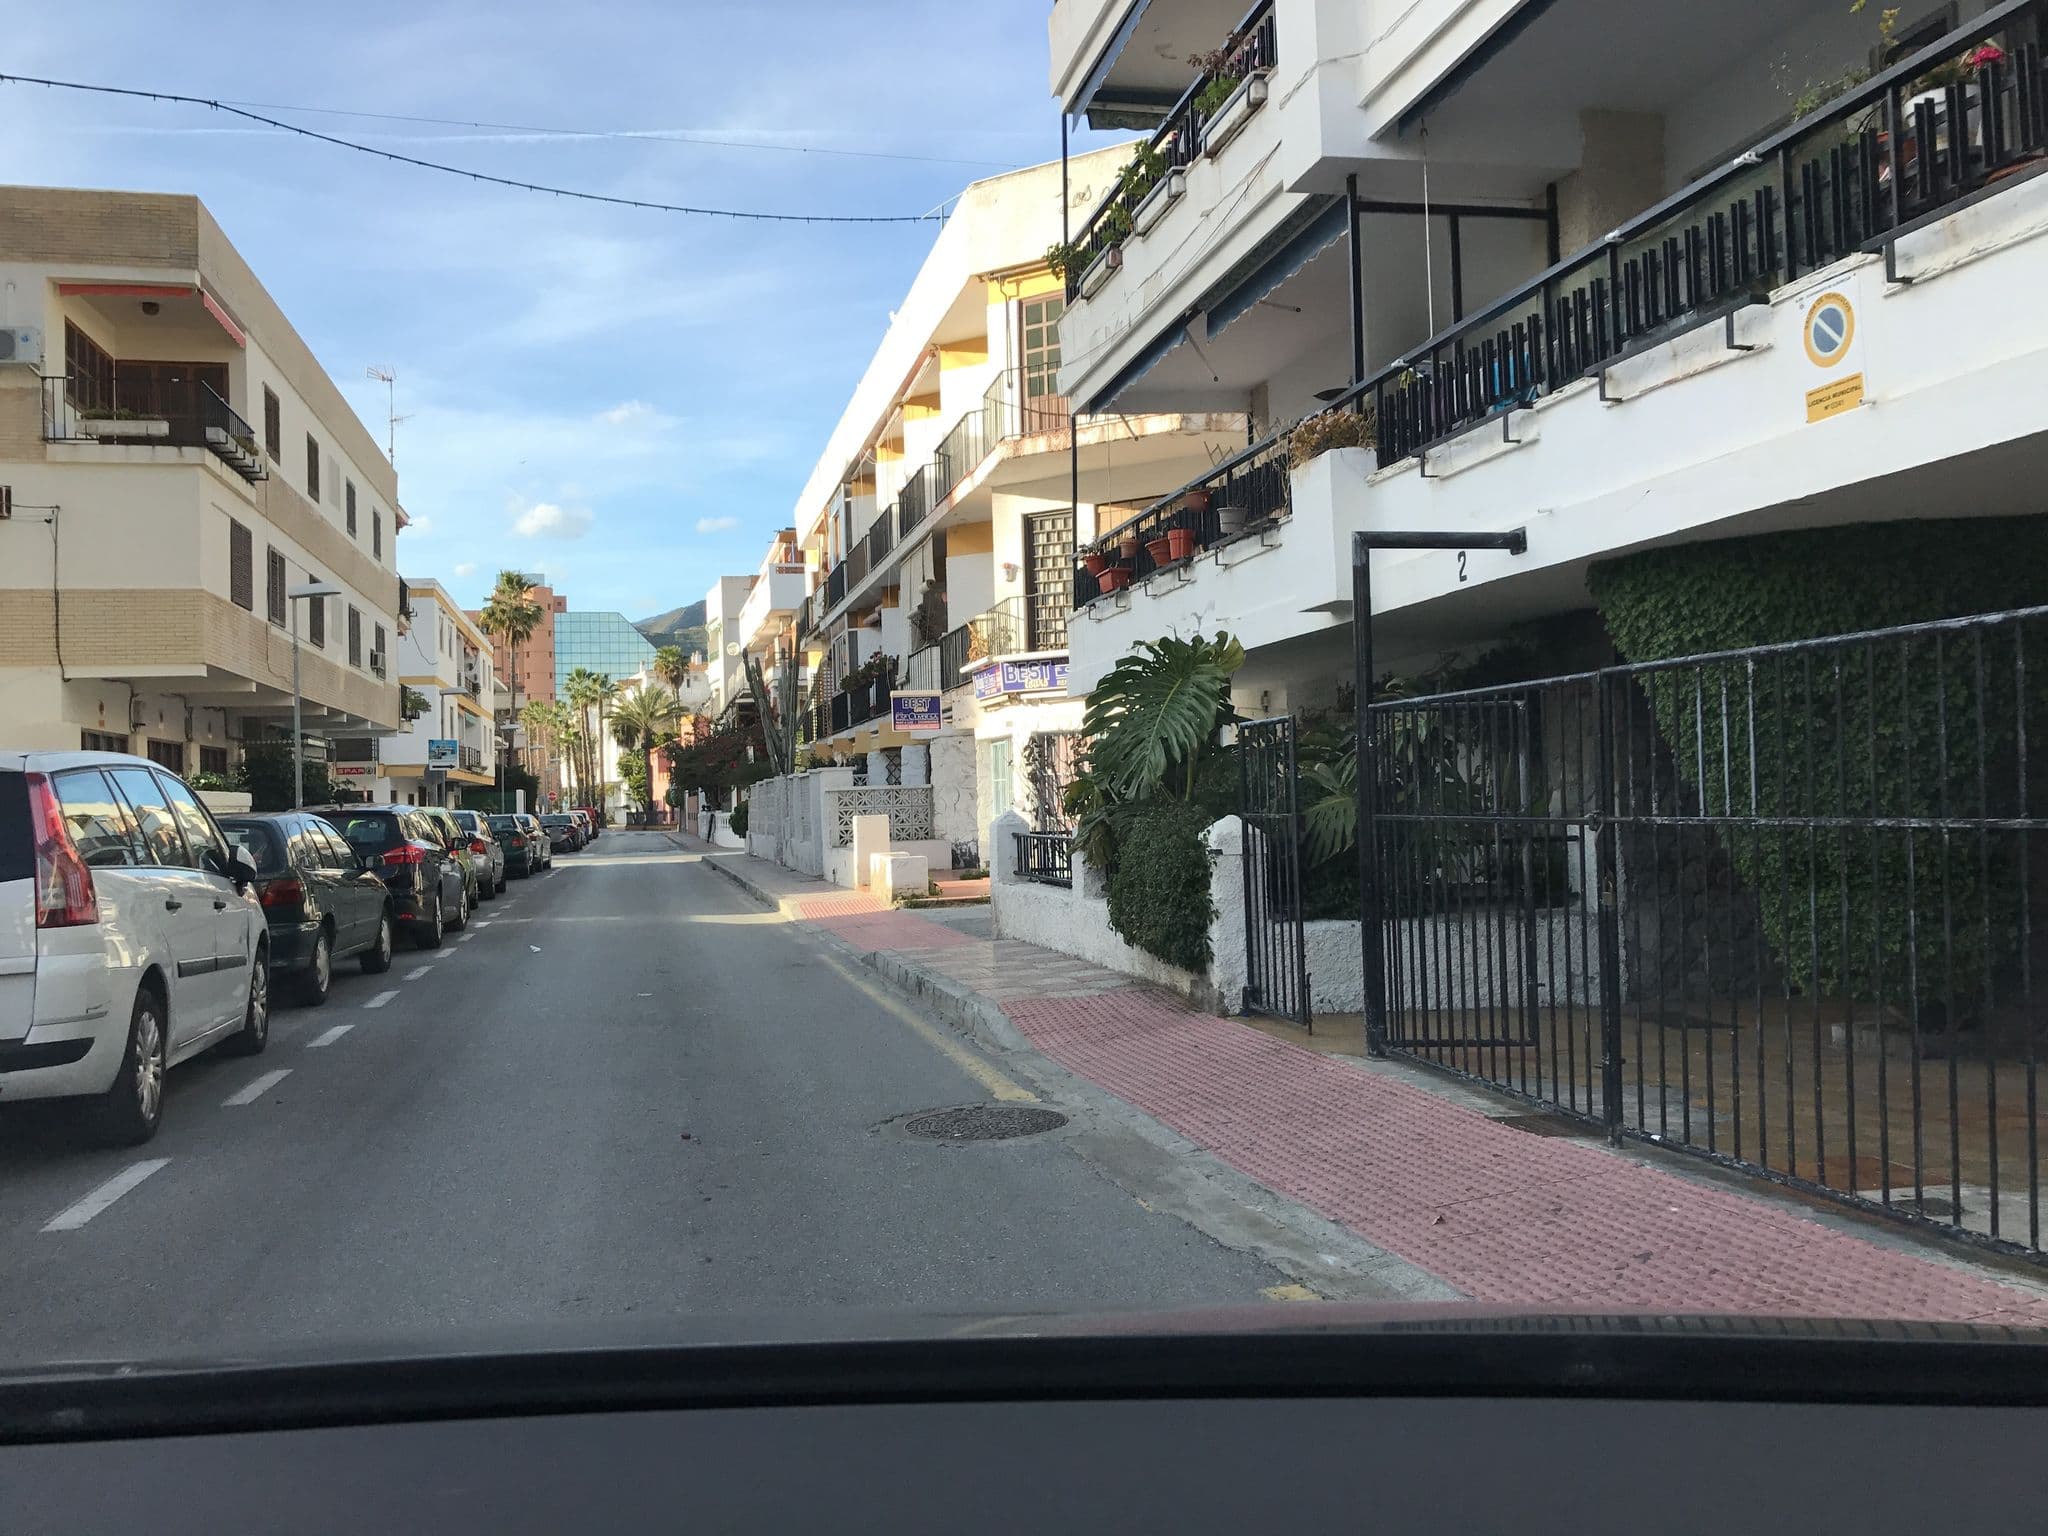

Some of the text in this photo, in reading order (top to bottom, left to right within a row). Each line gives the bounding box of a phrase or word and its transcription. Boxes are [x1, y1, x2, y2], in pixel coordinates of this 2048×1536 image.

[1457, 550, 1467, 582] 2
[1003, 661, 1051, 683] BEST
[902, 698, 931, 709] BEST
